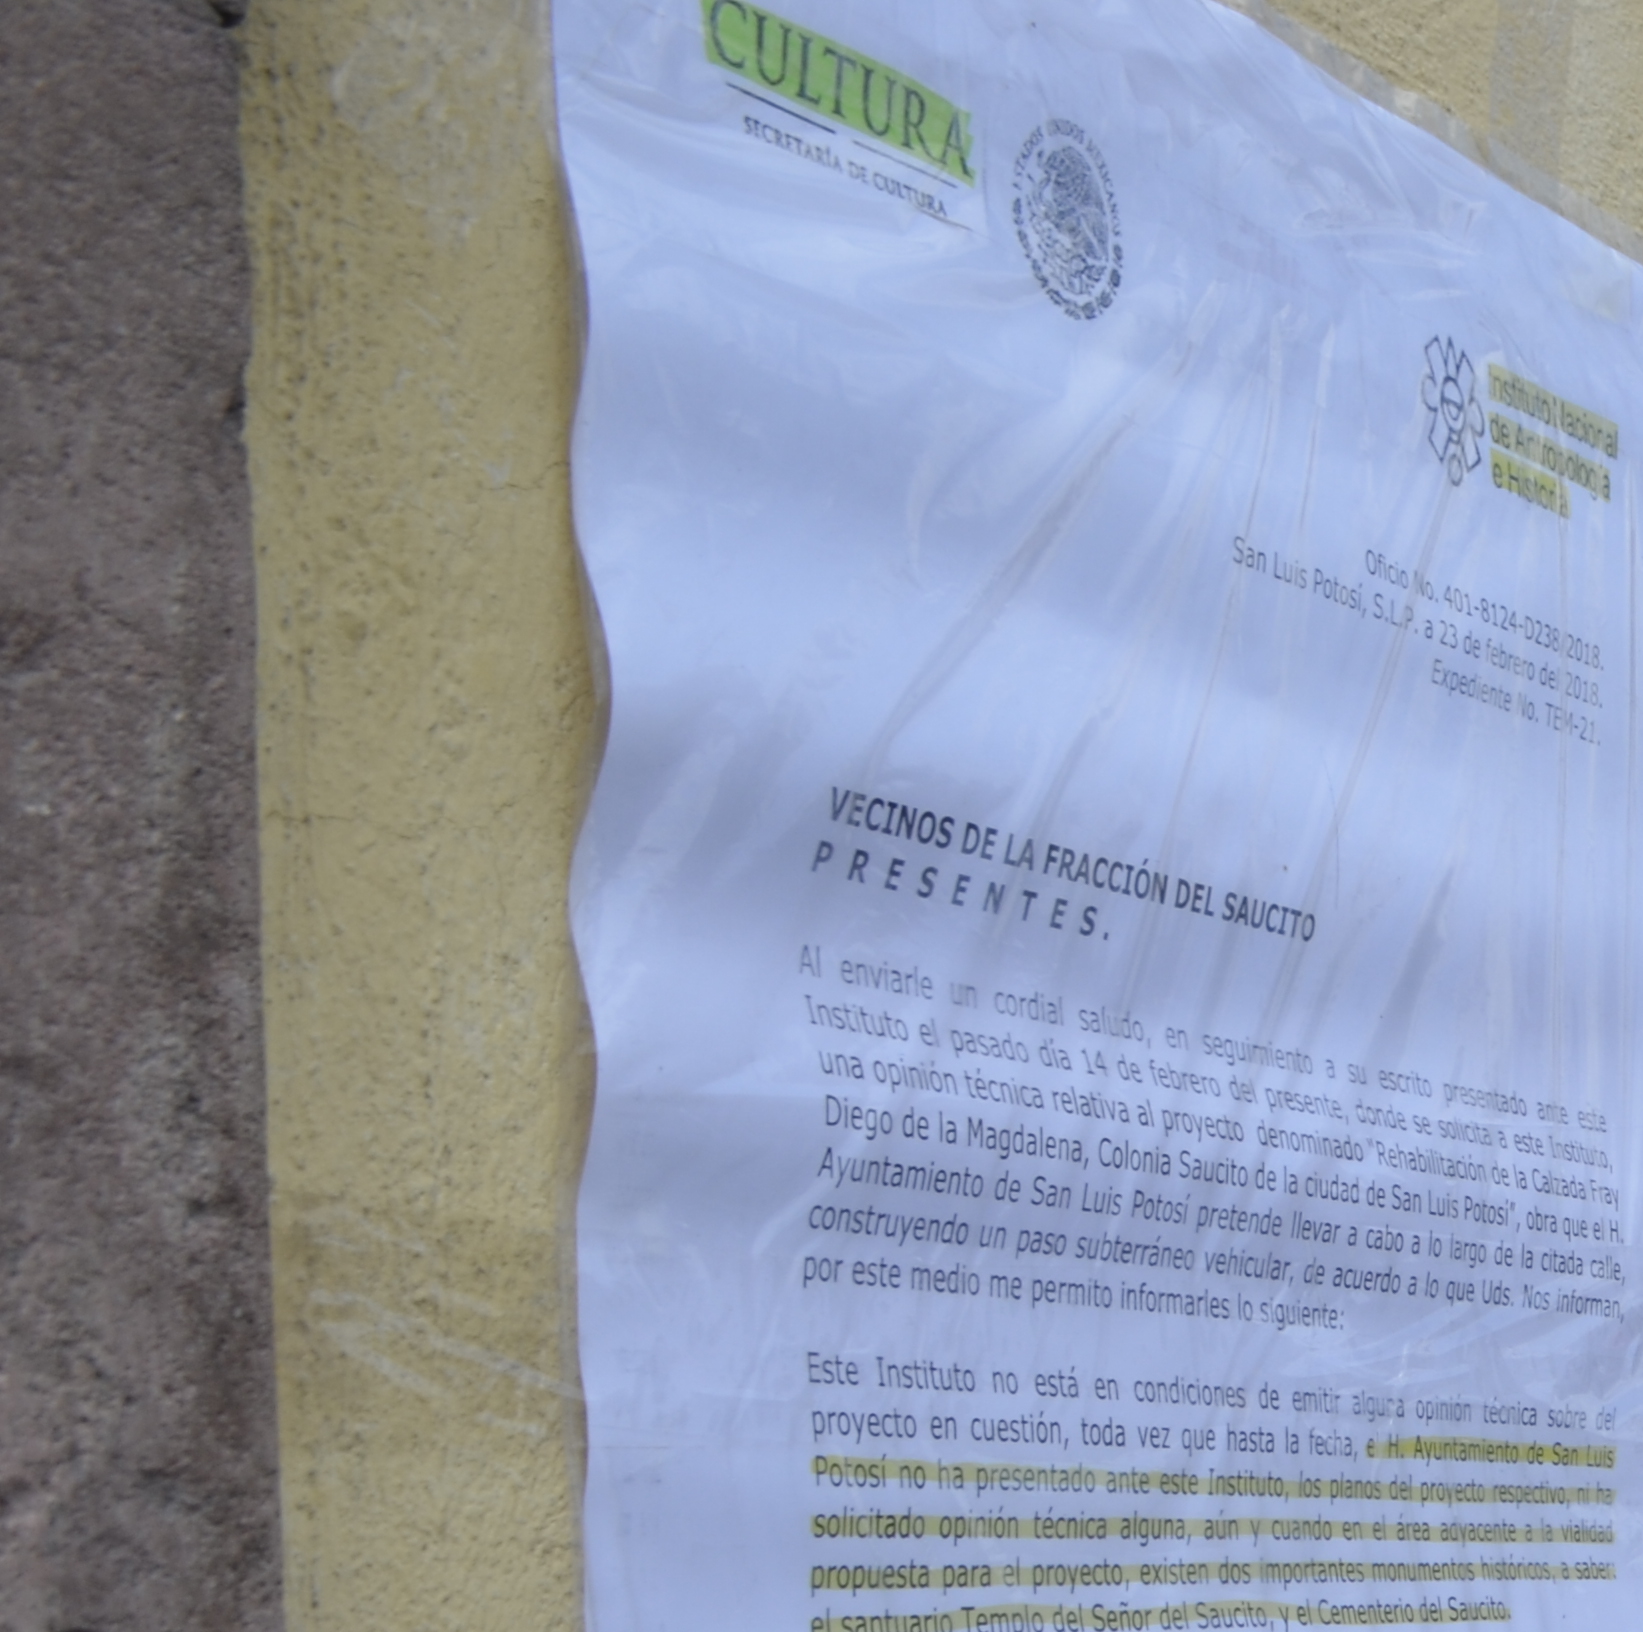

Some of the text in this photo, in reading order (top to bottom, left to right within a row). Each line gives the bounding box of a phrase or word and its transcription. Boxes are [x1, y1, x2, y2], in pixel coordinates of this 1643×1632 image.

[709, 0, 973, 178] CULTURA
[743, 115, 947, 216] SECRETARÍA DE CULTURA
[1490, 413, 1509, 448] de
[1493, 462, 1569, 519] e Historia
[1366, 549, 1409, 589] Oficio
[1413, 570, 1438, 602] No.
[1233, 536, 1266, 573] San
[1274, 552, 1307, 590] Luis
[1314, 568, 1366, 619] Potosí,
[1425, 619, 1433, 639] a
[1440, 620, 1458, 649] 23
[1463, 631, 1480, 658] de
[1485, 638, 1535, 680] febrero
[1539, 662, 1560, 690] del
[1565, 672, 1602, 708] 2018.
[1432, 658, 1511, 711] Expediente
[1517, 692, 1538, 722] No.
[830, 787, 1316, 941] VECINOS DE LA FRACCIÓN DEL SAUCITO
[803, 1256, 1345, 1331] por este medio me permito informarles lo siguiente:
[808, 1203, 1626, 1324] construyendo un paso subterráneo vehicular, de acuerdo a lo que Uds. Nos informan,
[1053, 1604, 1084, 1632] del
[1091, 1601, 1152, 1632] Señor
[1159, 1601, 1189, 1630] del
[1196, 1599, 1275, 1632] Saucito,
[1277, 1603, 1291, 1632] y
[1297, 1600, 1313, 1626] el
[1318, 1598, 1414, 1626] Cementerio
[1419, 1597, 1444, 1623] del
[1447, 1596, 1511, 1623] Saucito.
